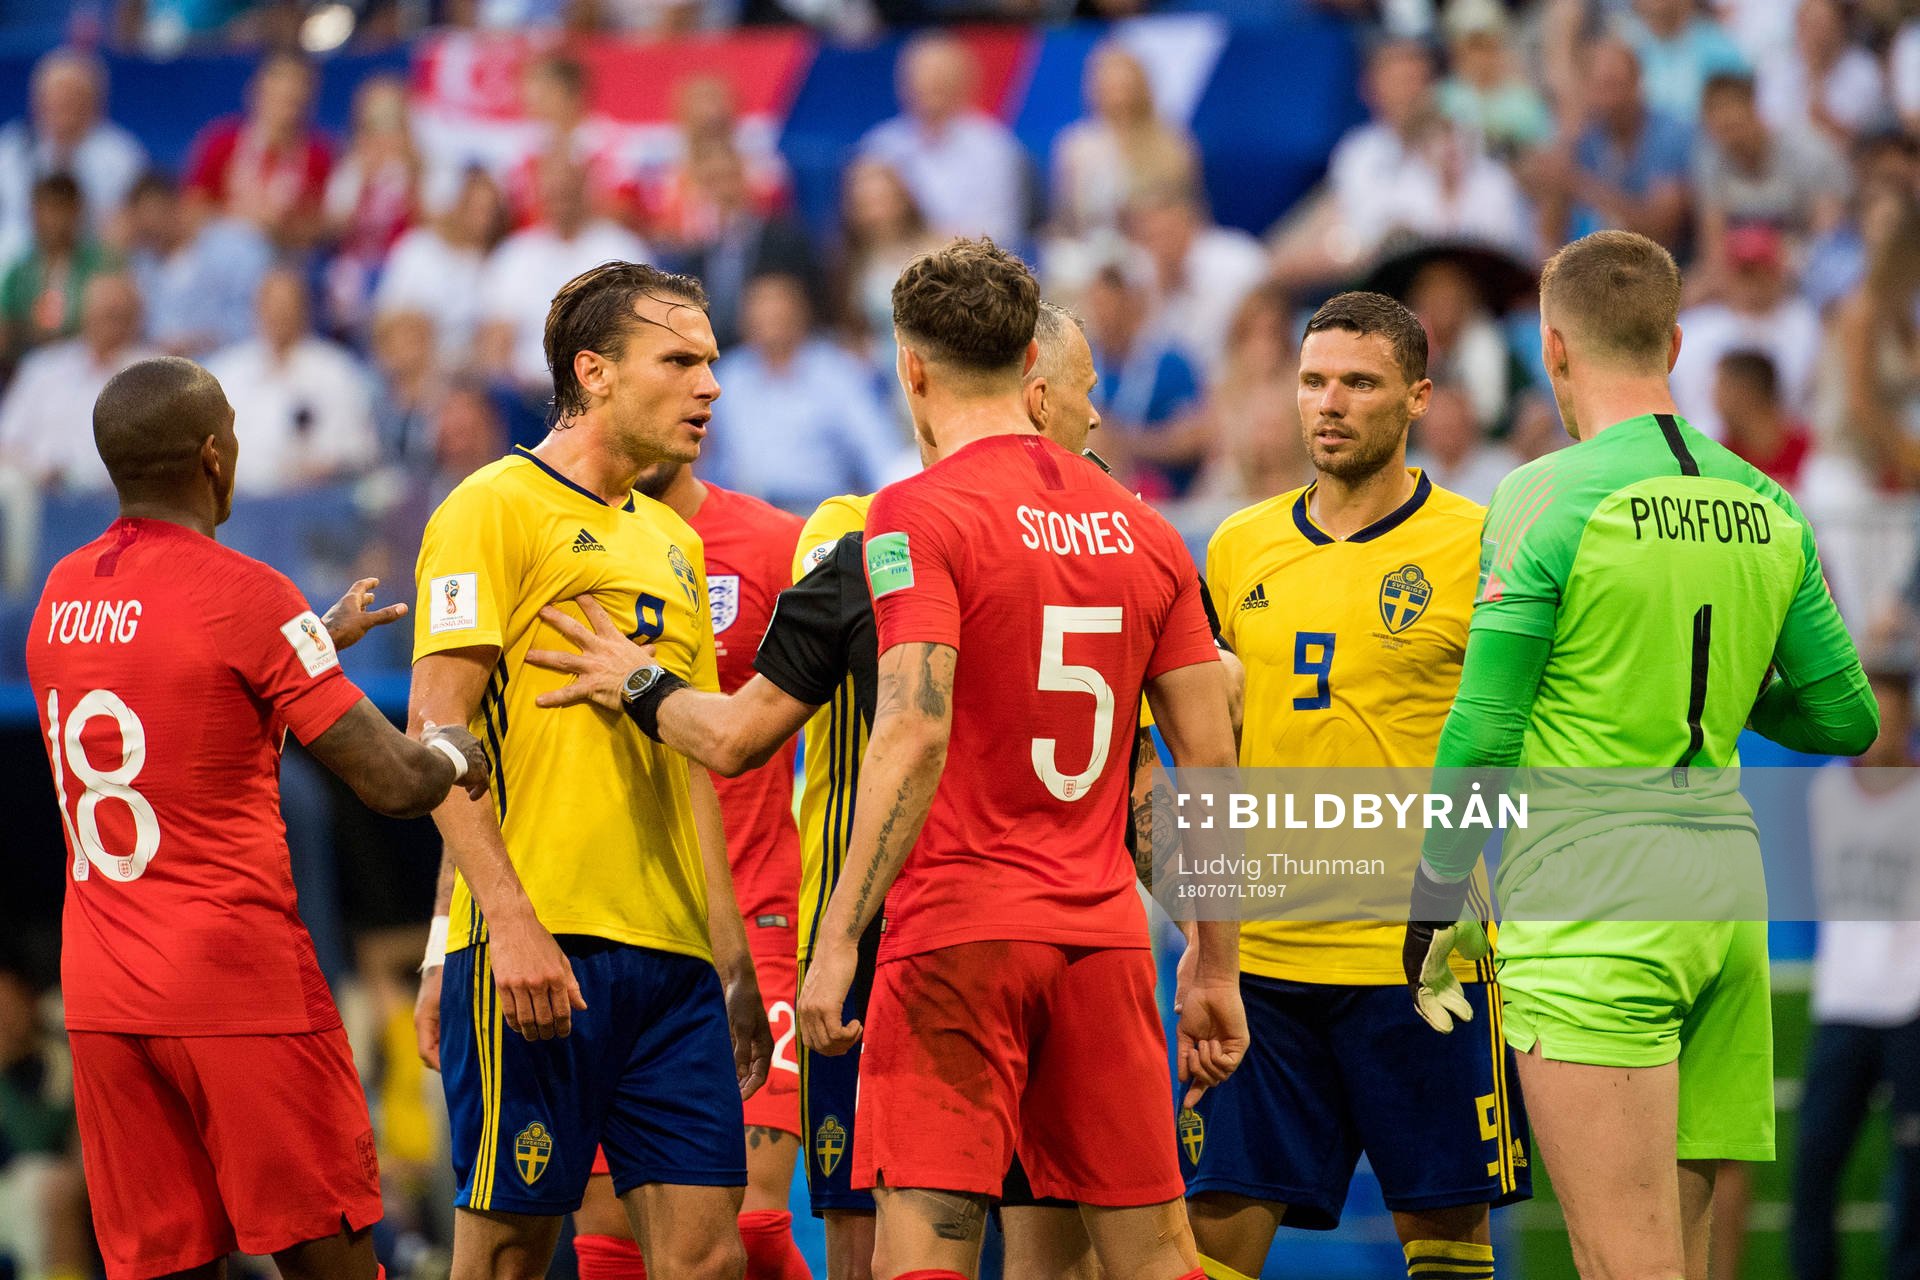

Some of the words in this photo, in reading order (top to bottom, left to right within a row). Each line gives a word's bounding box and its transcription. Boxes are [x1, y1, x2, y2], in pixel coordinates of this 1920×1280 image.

[1016, 505, 1135, 556] STONES
[1631, 496, 1771, 544] PICKFORD
[572, 543, 606, 553] adidas
[891, 566, 908, 575] FIFA
[1240, 600, 1269, 611] adidas
[1391, 581, 1423, 594] SVERIGE
[48, 600, 142, 644] YOUNG
[1293, 631, 1336, 711] 9
[1031, 605, 1123, 802] 5
[1671, 604, 1713, 788] 1
[48, 689, 161, 883] 18
